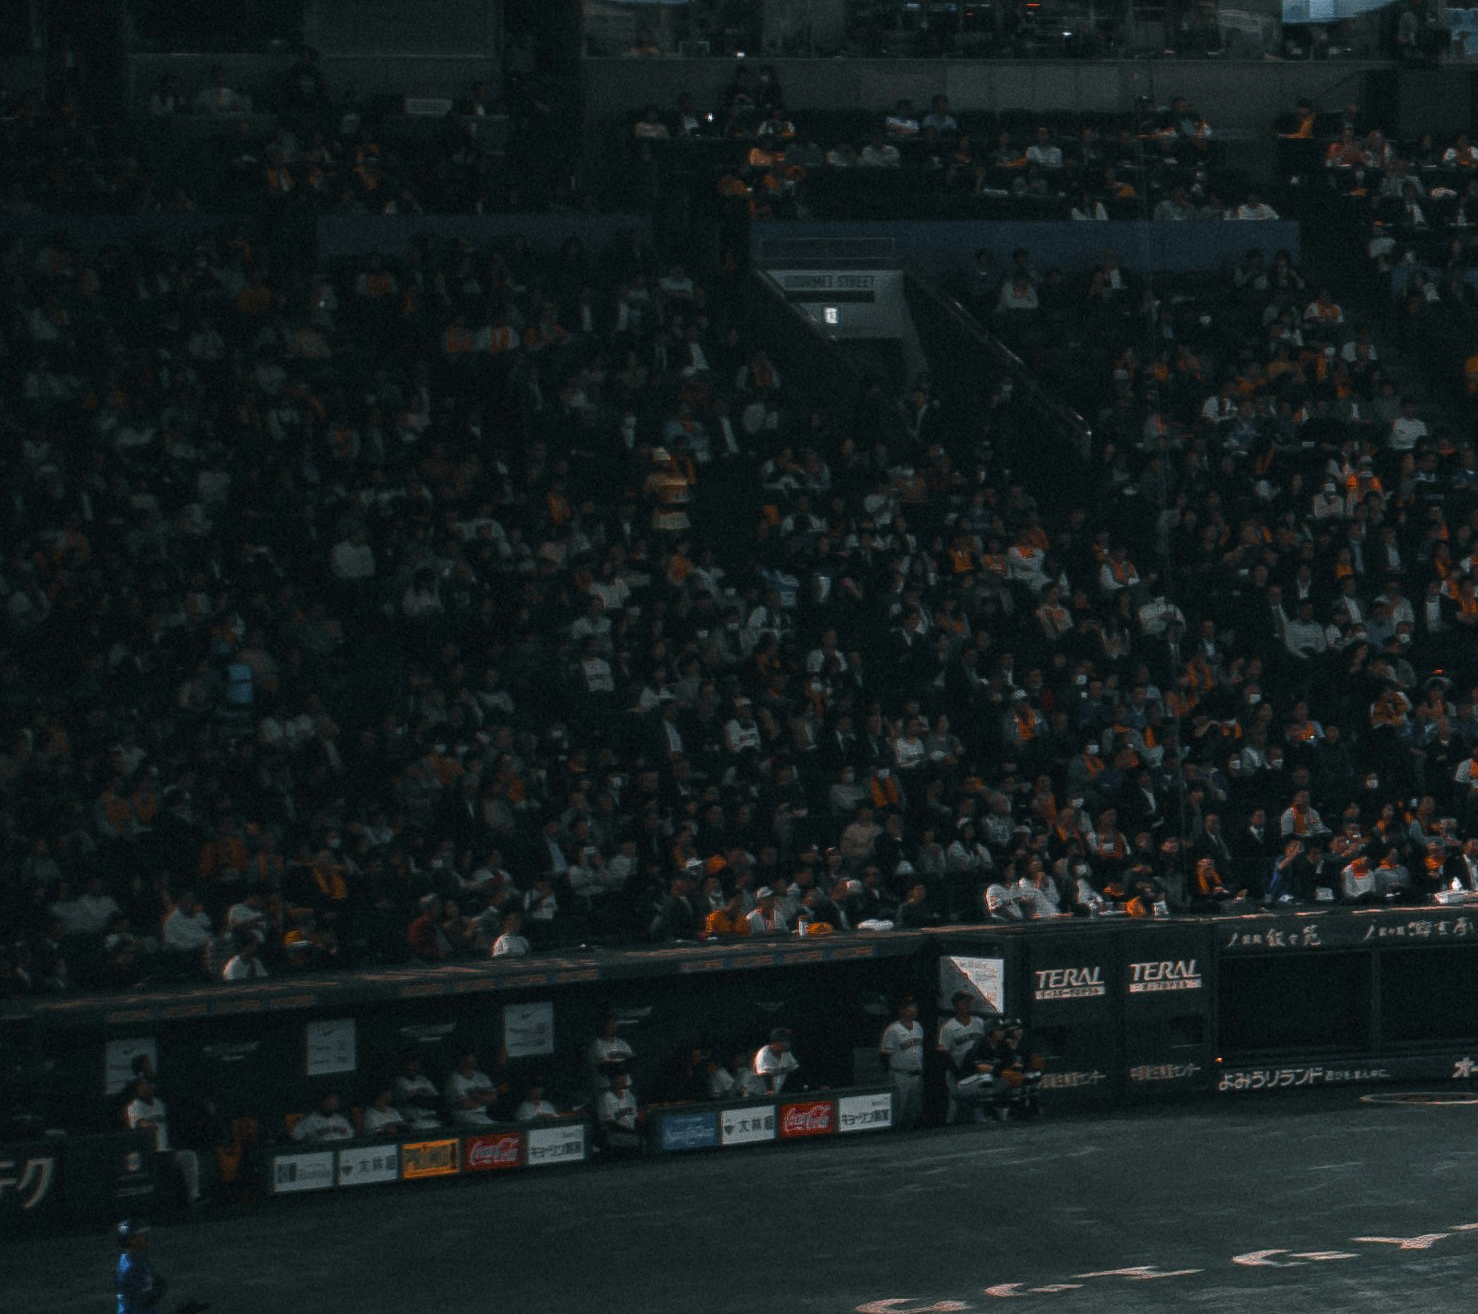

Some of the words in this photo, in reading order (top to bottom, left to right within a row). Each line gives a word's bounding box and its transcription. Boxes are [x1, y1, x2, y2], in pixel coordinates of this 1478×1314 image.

[1034, 965, 1106, 989] TERAL
[1129, 958, 1202, 982] TERAL
[1217, 1067, 1323, 1093] よみうりランド
